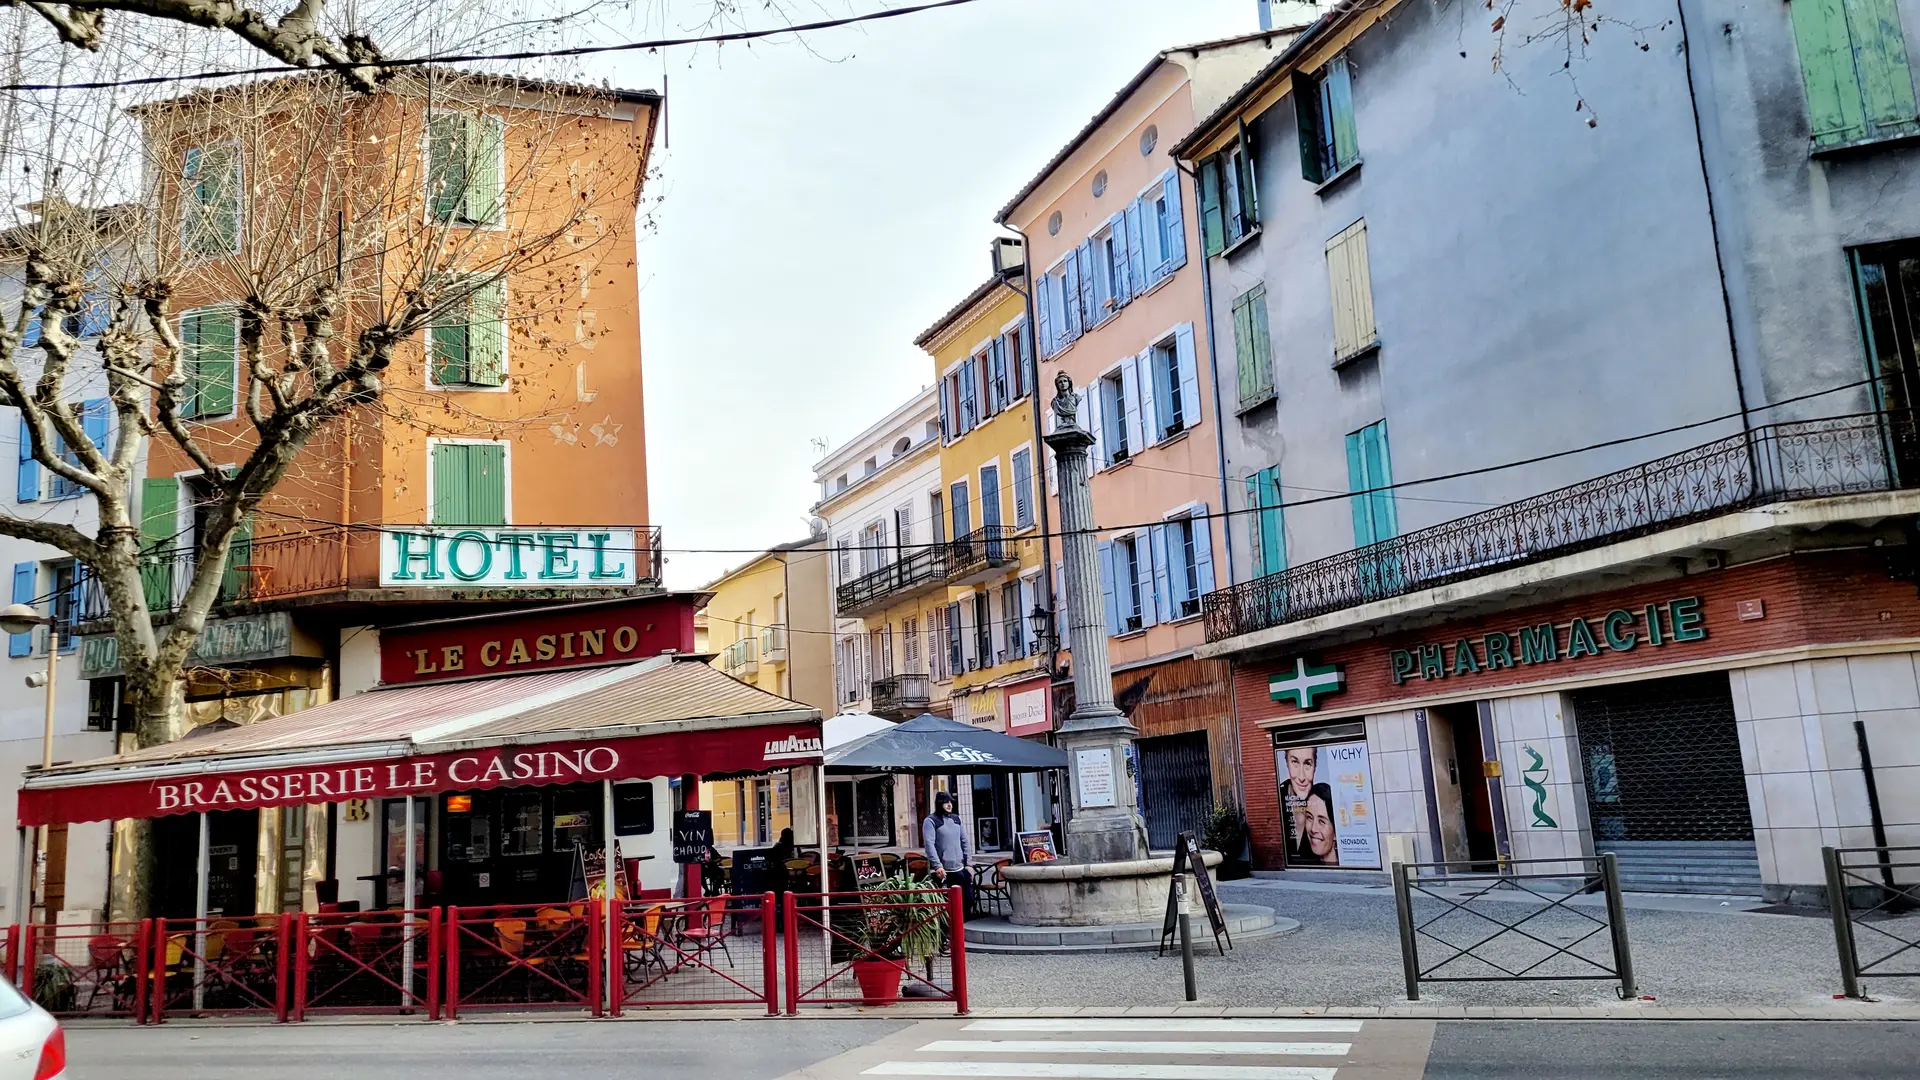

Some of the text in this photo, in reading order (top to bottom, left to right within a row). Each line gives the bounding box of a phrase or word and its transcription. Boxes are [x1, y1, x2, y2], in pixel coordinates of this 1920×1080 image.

[391, 531, 625, 581] HOTEL
[1389, 596, 1706, 685] PHARMACIE
[971, 692, 998, 718] HAIR
[971, 714, 995, 725] DIVERSION
[764, 735, 822, 754] LAVAZZA
[934, 747, 996, 763] Leffe
[1330, 746, 1364, 760] VICHY
[156, 746, 620, 811] BRASSERIE LE CASINO
[679, 829, 706, 842] VIN
[1340, 837, 1368, 846] NEOVADIOL
[673, 844, 707, 857] CHAUD
